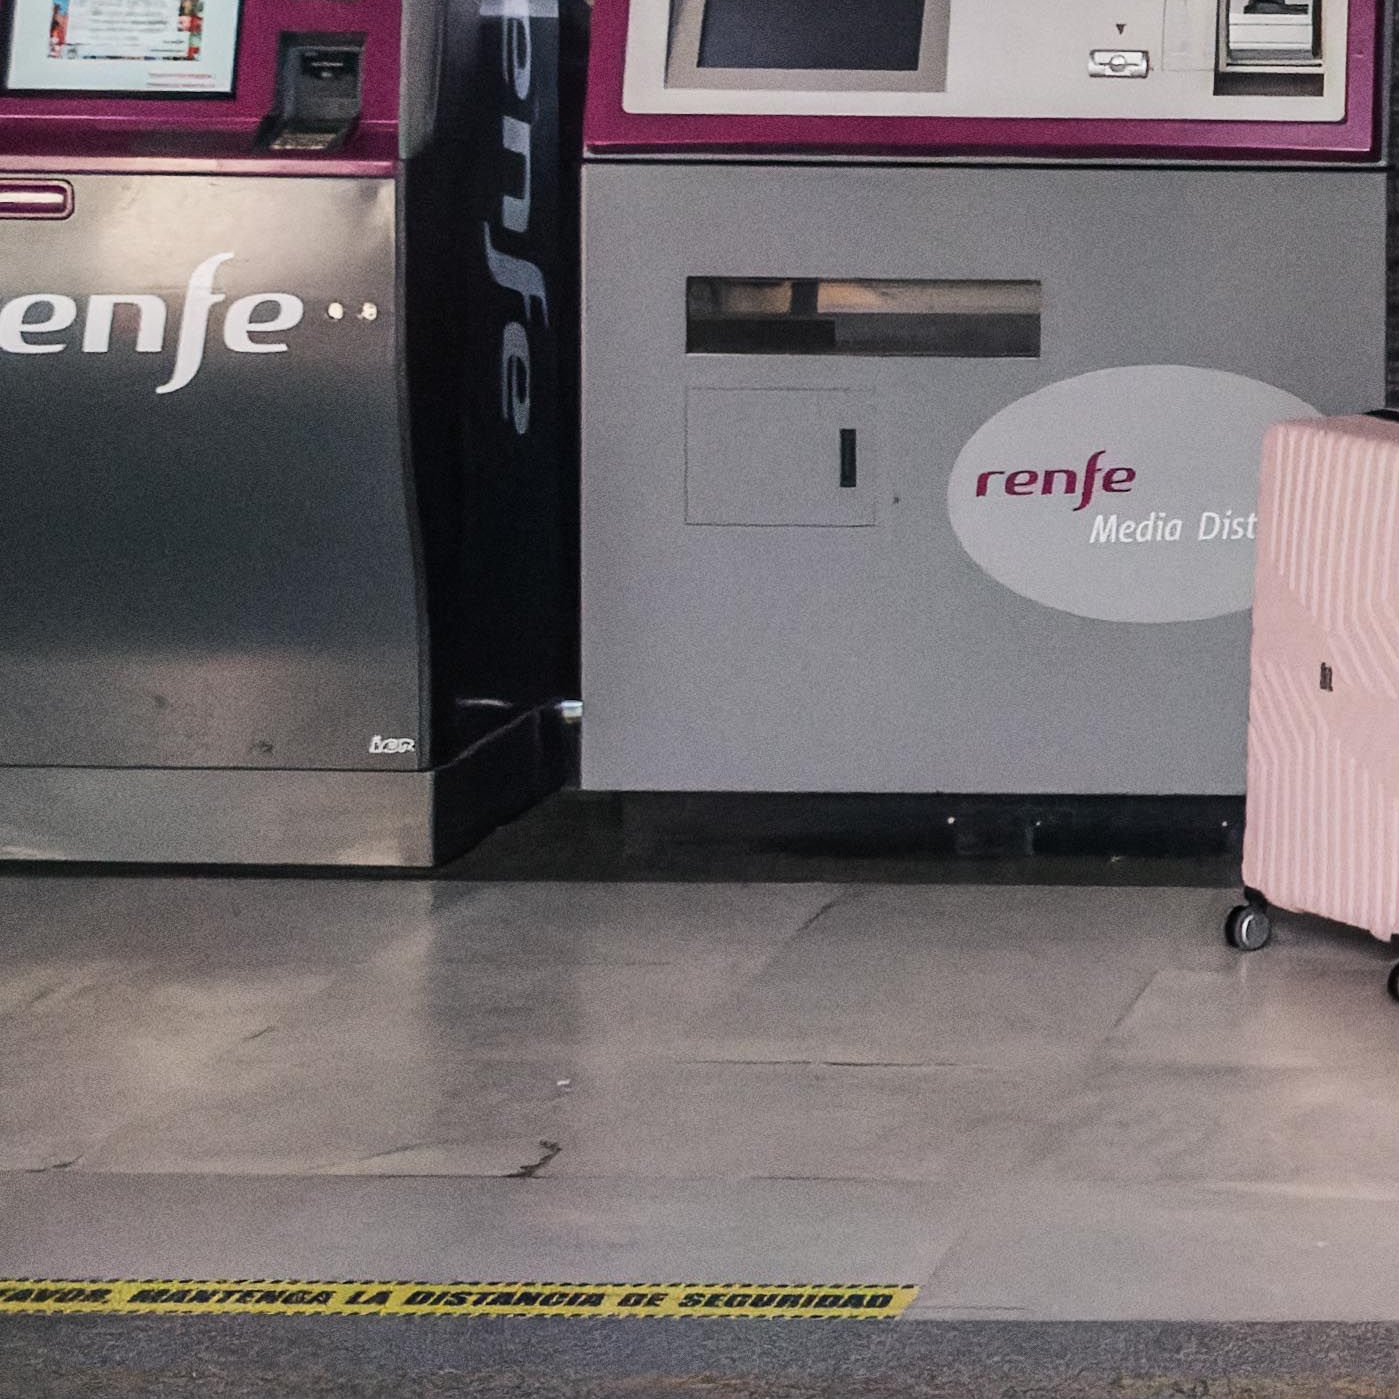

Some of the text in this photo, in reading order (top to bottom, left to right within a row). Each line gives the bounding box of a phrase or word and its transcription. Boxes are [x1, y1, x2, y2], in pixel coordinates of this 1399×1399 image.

[0, 252, 304, 395] enfe
[975, 450, 1137, 512] renfe
[1090, 510, 1257, 544] Media Dist
[127, 1289, 335, 1306] MANTENGA
[345, 1290, 391, 1306] LA
[403, 1291, 605, 1307] DISTANCIA
[617, 1292, 669, 1307] DE
[679, 1293, 893, 1309] SEGURIDAD
